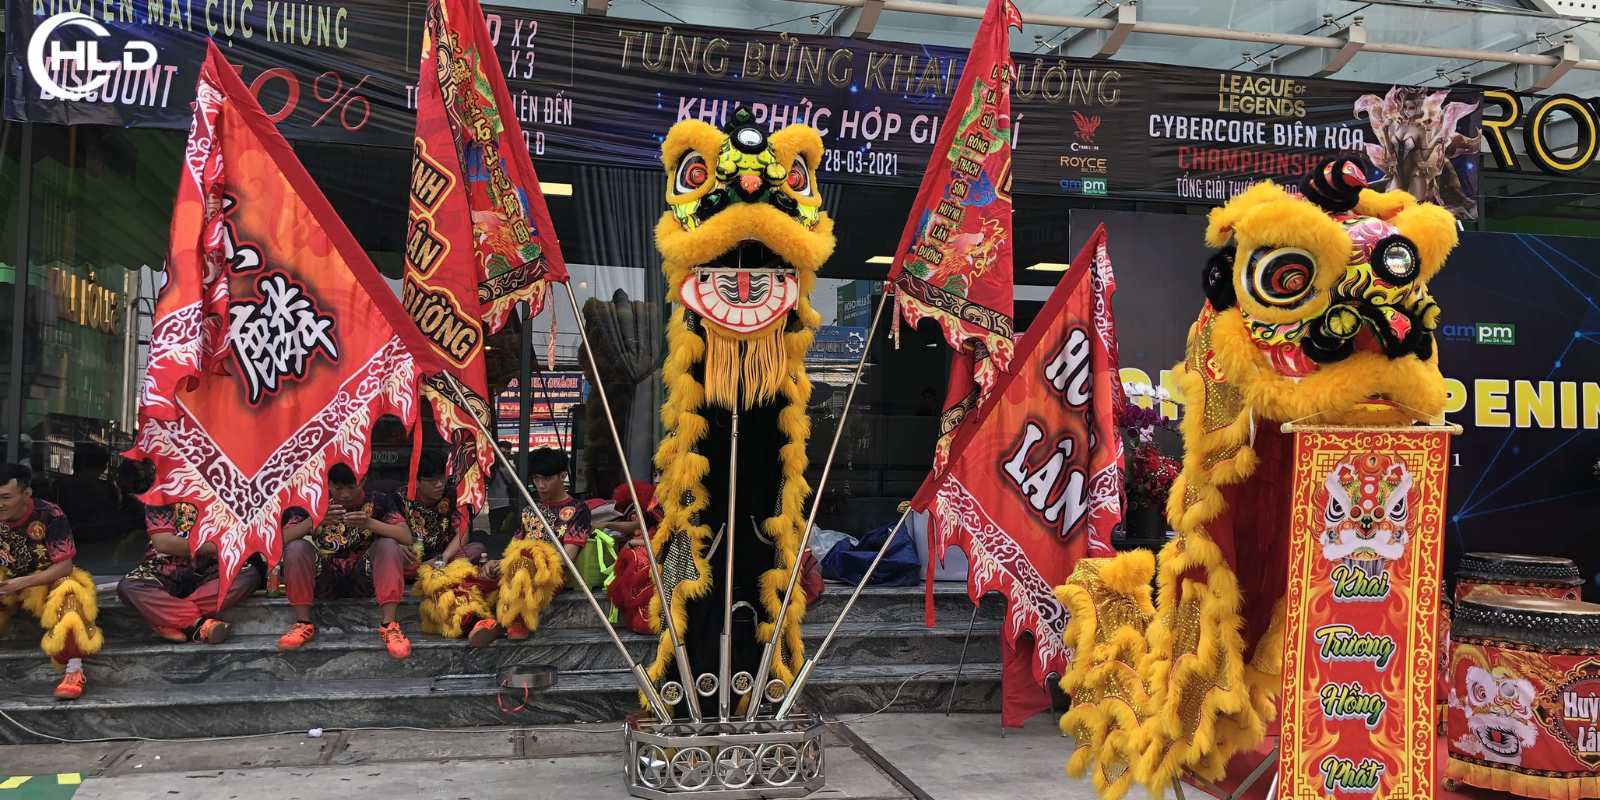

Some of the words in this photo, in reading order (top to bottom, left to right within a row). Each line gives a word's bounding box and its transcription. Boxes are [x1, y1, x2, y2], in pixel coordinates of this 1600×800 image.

[864, 52, 958, 96] KHAI
[1015, 57, 1121, 108] ƯƠNG
[1219, 73, 1295, 98] LEAGUE
[1294, 85, 1307, 95] OF
[543, 90, 573, 126] ĐẾN
[1218, 93, 1307, 118] LEGENDS
[839, 106, 902, 150] HỢP
[910, 114, 939, 144] GI
[966, 133, 989, 153] RỒNG
[1149, 114, 1266, 145] CYBERCORE
[1273, 120, 1317, 148] BIÊN
[1324, 123, 1365, 151] HÒA
[1481, 91, 1600, 171] RO
[825, 149, 898, 176] 28-03-2021
[957, 157, 981, 176] THẠCH
[1060, 155, 1107, 169] ROYCE
[1178, 147, 1324, 176] CHAMPIONSH
[952, 181, 967, 198] SƠN
[1176, 171, 1203, 198] TỔNG
[1205, 175, 1226, 200] GIẢI
[937, 203, 962, 221] HUỲNH
[931, 225, 949, 242] LÂN
[917, 245, 943, 265] ĐƯỜNG
[1429, 378, 1600, 429] PENI
[1003, 423, 1089, 537] LÂN
[1332, 566, 1390, 598] Khai
[1316, 624, 1395, 669] Trương
[1320, 683, 1386, 726] Hồng
[1563, 691, 1600, 724] Huỳ
[1320, 756, 1384, 792] Phát
